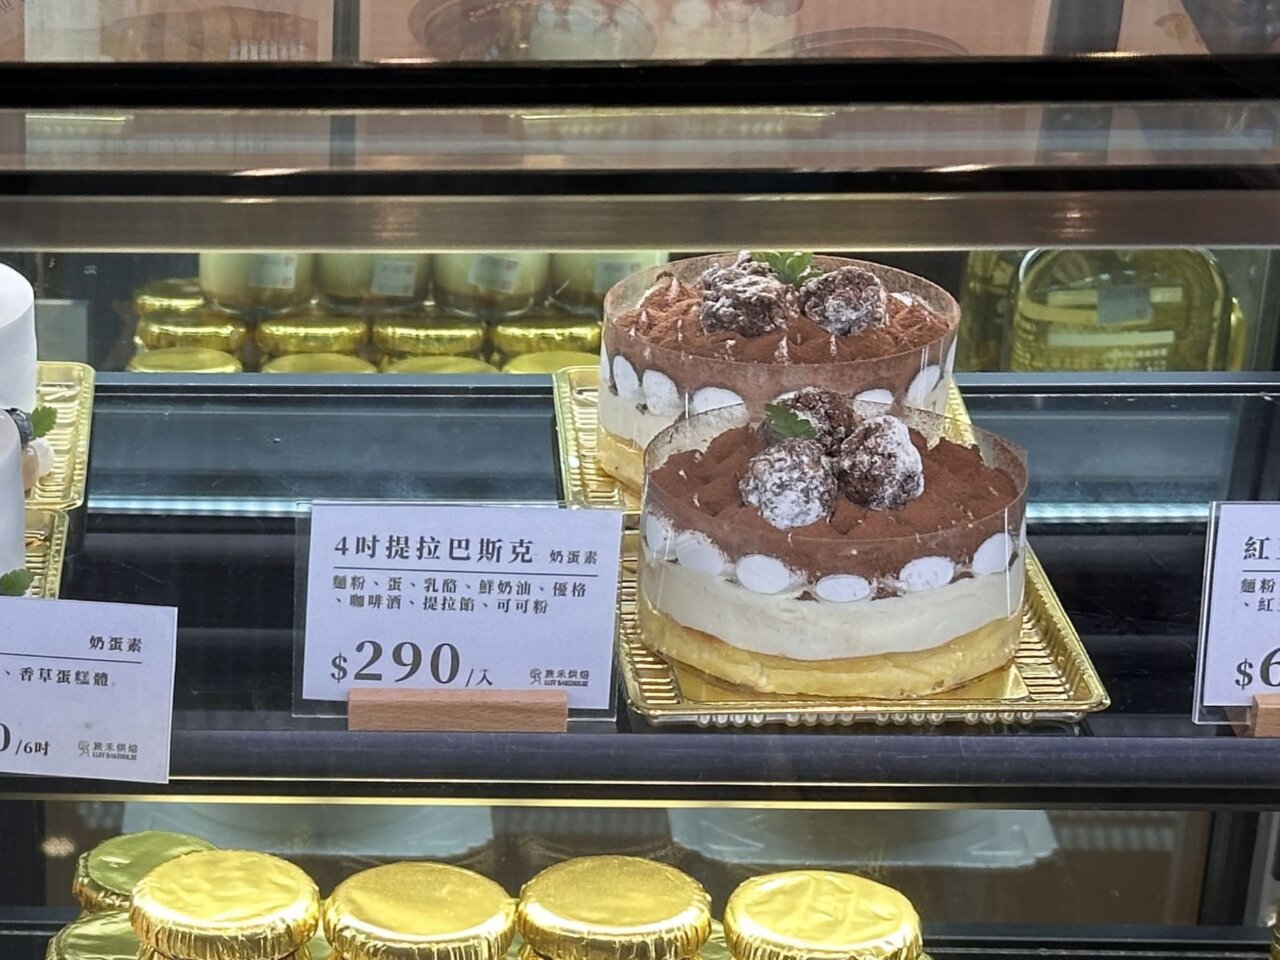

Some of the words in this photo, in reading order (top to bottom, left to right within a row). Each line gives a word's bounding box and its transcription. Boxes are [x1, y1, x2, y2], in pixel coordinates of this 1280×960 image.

[334, 535, 535, 564] 4吋提拉巴斯克
[549, 549, 598, 564] 奶蛋素
[1243, 536, 1280, 560] 紅
[88, 635, 143, 653] 奶蛋素
[330, 640, 493, 688] $290/入
